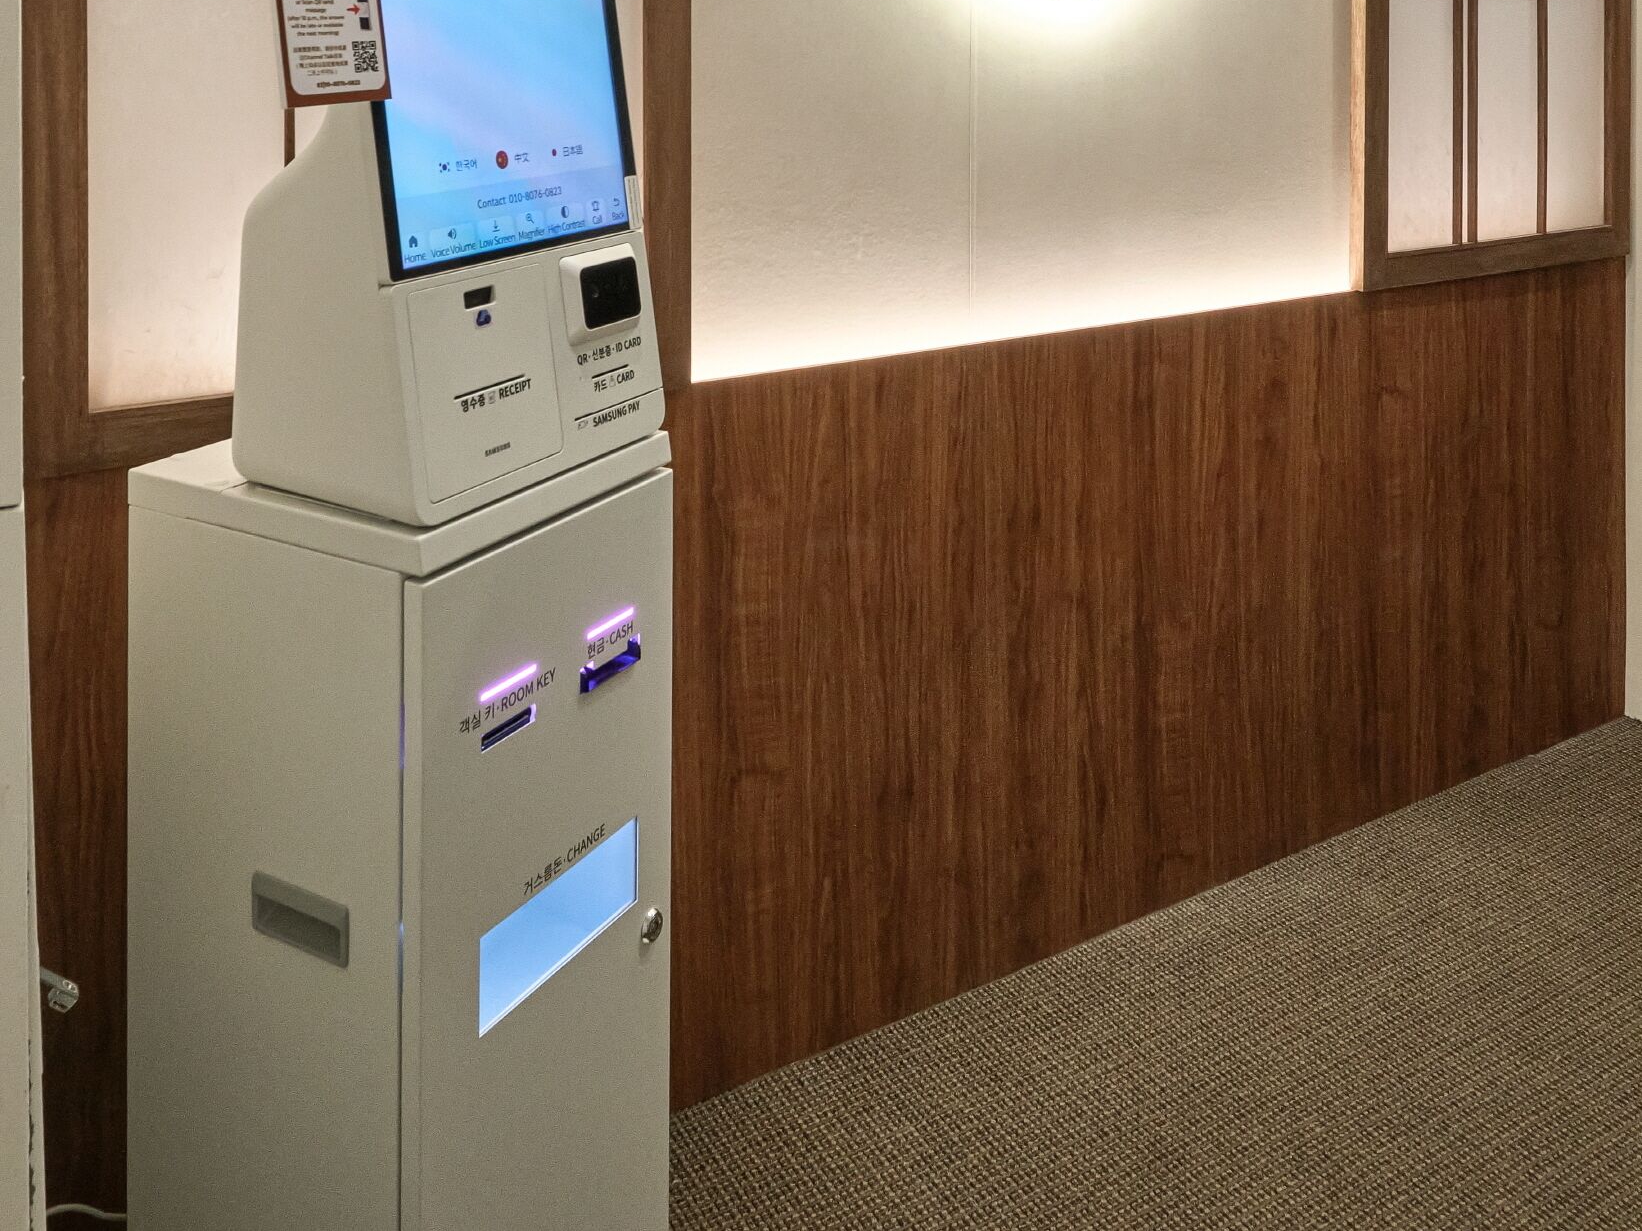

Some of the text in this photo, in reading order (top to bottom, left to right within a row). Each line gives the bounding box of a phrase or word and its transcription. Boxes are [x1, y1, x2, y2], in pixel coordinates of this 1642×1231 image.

[455, 158, 478, 171] 한국어
[514, 152, 530, 163] 中文
[477, 186, 562, 209] Contact 010-8076-0823
[592, 215, 602, 225] Call
[612, 211, 625, 221] Back
[562, 220, 585, 232] Contrast
[519, 227, 545, 240] Magnifier
[479, 234, 516, 249] Low Screen
[431, 242, 476, 258] Voice Volume
[404, 252, 426, 264] Home
[624, 336, 641, 350] CARD
[616, 369, 634, 384] CARD
[499, 379, 531, 399] RECEIPT
[594, 379, 608, 392] 카드
[461, 393, 485, 413] 영수증
[593, 401, 640, 427] SAMSUNG PAY
[459, 709, 481, 734] 객실
[536, 667, 556, 691] KEY
